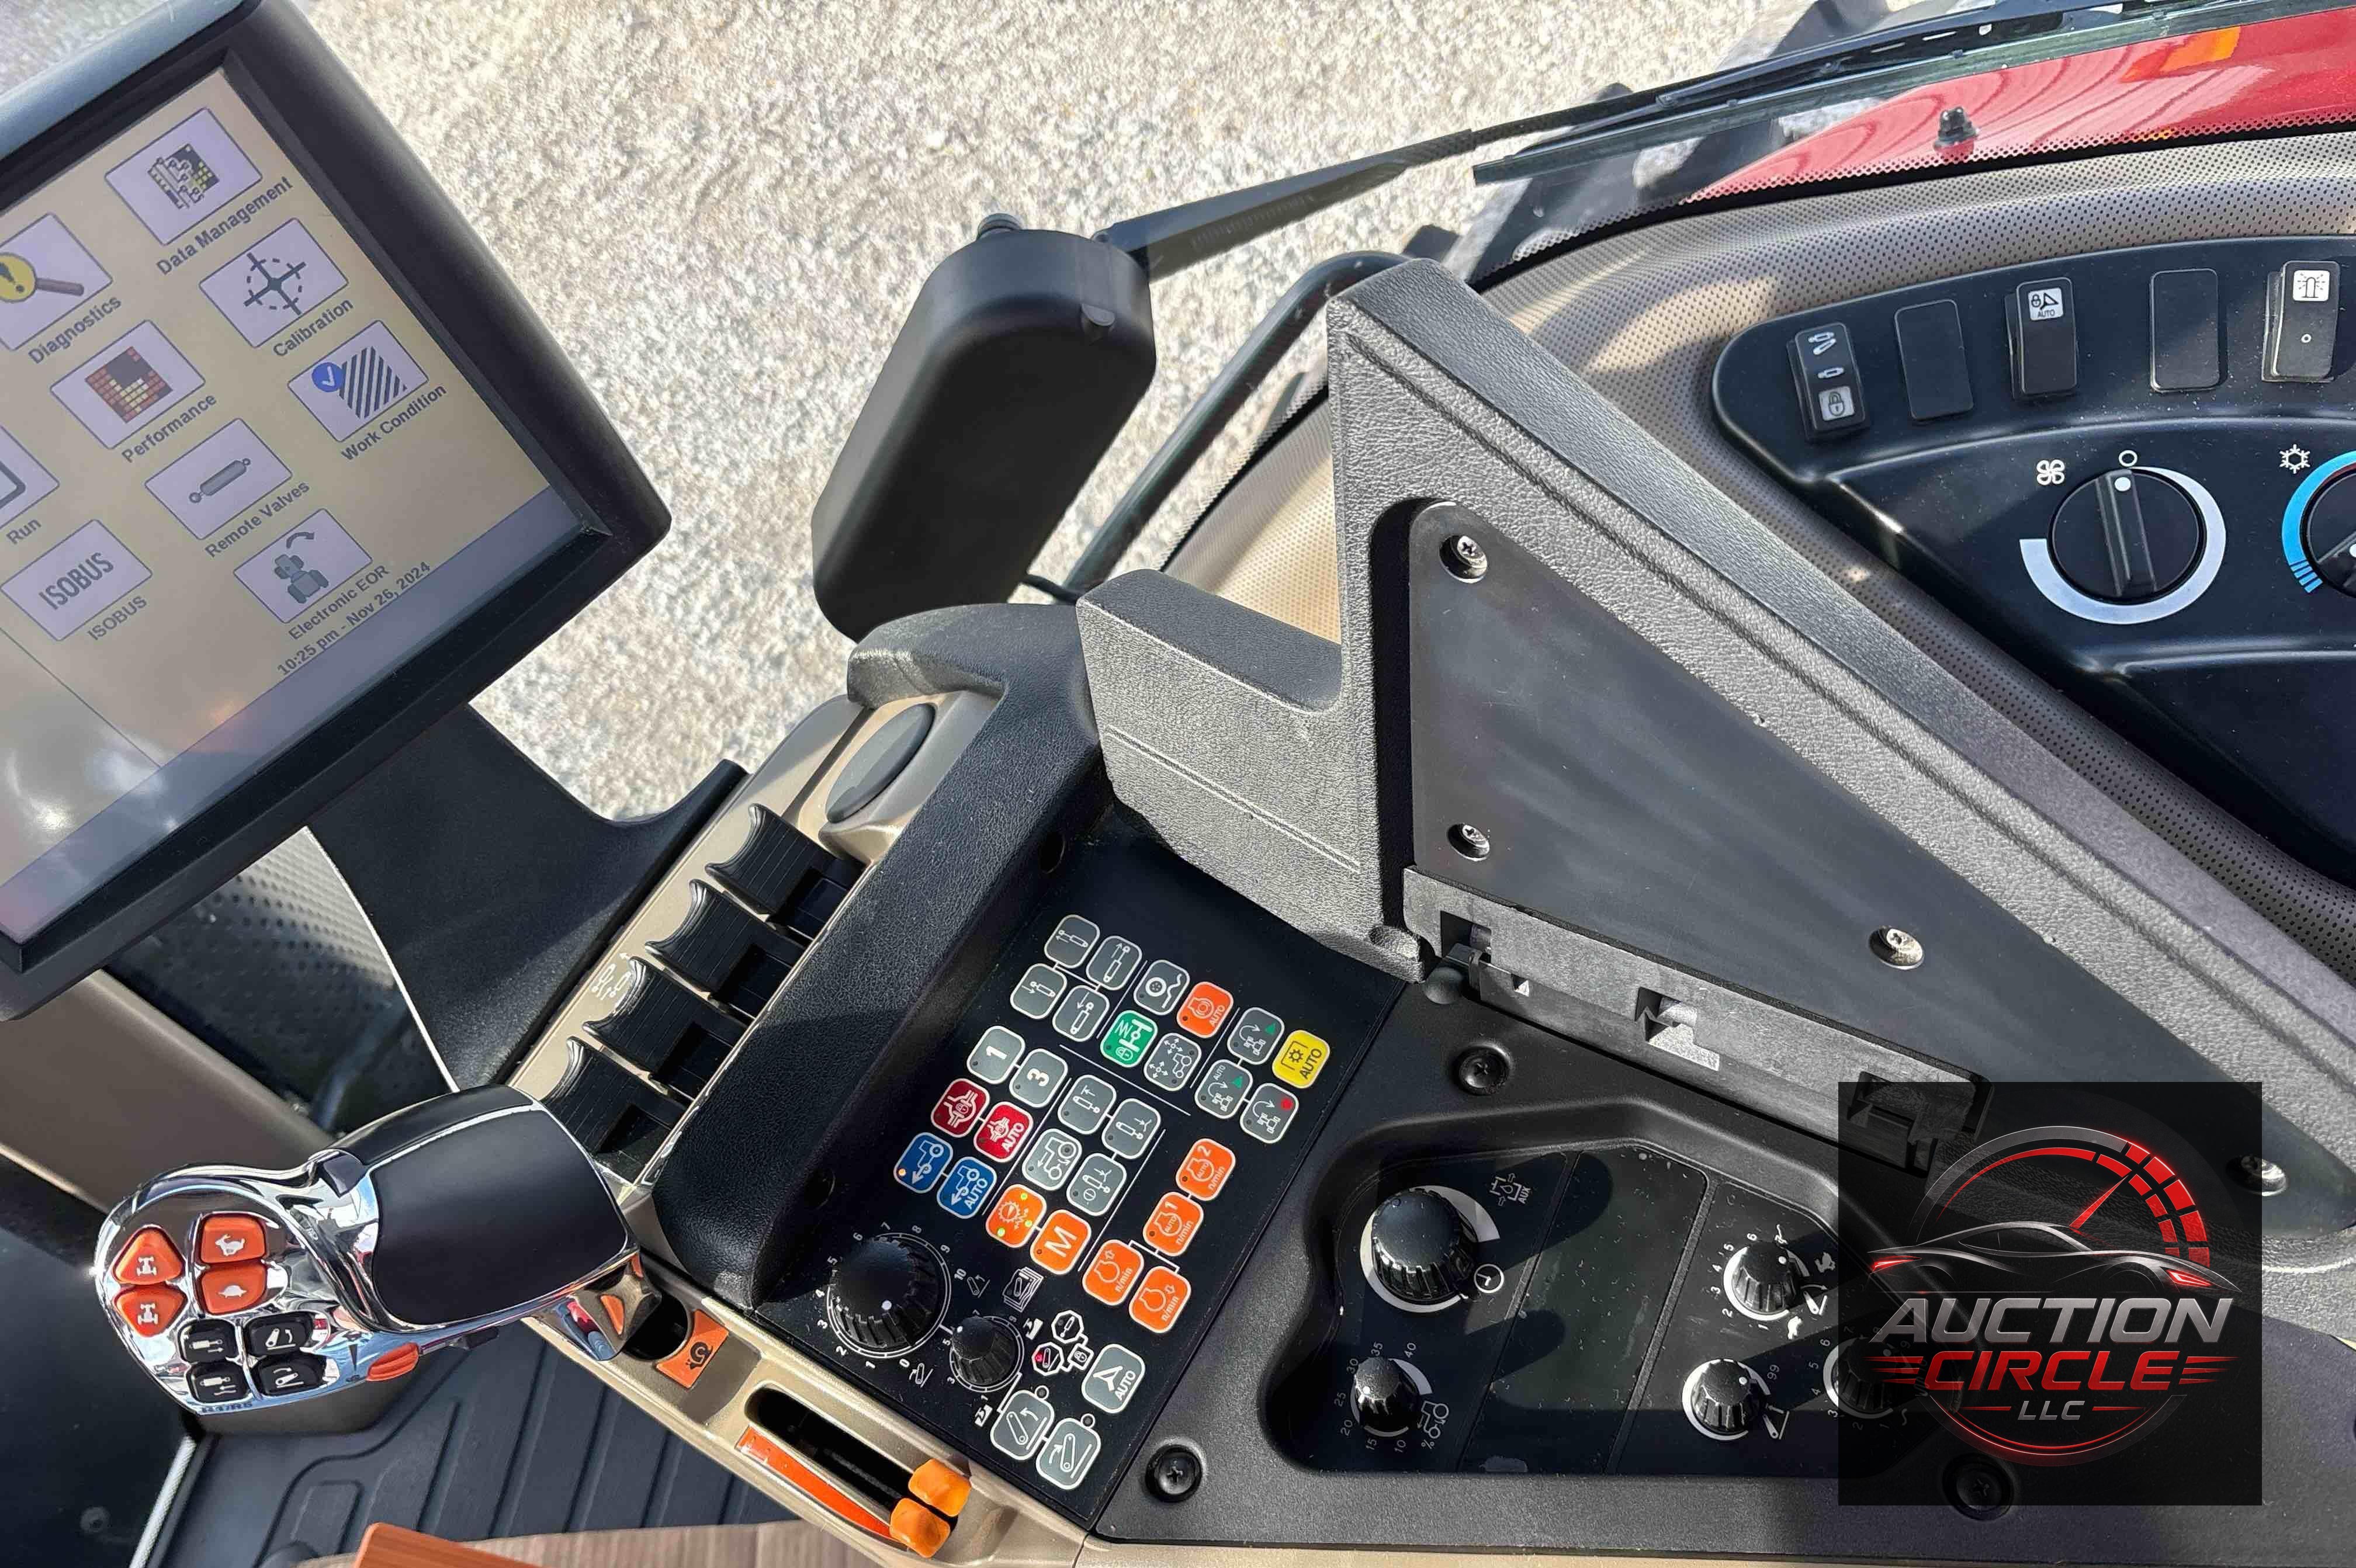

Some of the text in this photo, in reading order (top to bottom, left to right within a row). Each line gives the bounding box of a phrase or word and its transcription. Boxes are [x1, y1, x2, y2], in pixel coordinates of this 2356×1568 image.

[156, 175, 294, 276] Data Management
[2037, 309, 2056, 318] AUTO
[28, 297, 122, 363] Diagnostics
[273, 298, 354, 357] Calibration
[122, 394, 217, 463] Performance
[341, 384, 448, 462] Work Condition
[205, 482, 311, 558] Remote Valves
[6, 519, 41, 544] Run
[39, 553, 115, 610] ISOBUS
[288, 564, 390, 641] Electronic EOR
[87, 596, 147, 640] ISOBUS
[276, 645, 317, 677] 10:25
[316, 630, 339, 650] pm
[345, 602, 375, 627] Nov
[374, 588, 399, 606] 26,
[396, 561, 431, 590] 2024
[1210, 1005, 1226, 1026] AUTO
[986, 1045, 1007, 1059] 1
[1299, 1047, 1323, 1079] AUTO
[1027, 1069, 1049, 1087] 3
[1213, 1065, 1226, 1080] AUTO
[1002, 1122, 1025, 1152] AUTO
[1197, 1144, 1212, 1157] 2
[1208, 1166, 1225, 1191] n/min
[964, 1178, 988, 1209] AUTO
[1518, 1187, 1532, 1204] AUX
[1165, 1201, 1179, 1210] 1
[881, 1222, 891, 1230] 7
[912, 1225, 921, 1234] 8
[1176, 1219, 1194, 1246] n/min
[853, 1233, 863, 1241] 6
[1045, 1226, 1077, 1258] M
[1747, 1233, 1758, 1241] 6
[941, 1244, 950, 1254] 9
[1723, 1243, 1734, 1251] 5
[827, 1257, 838, 1265] 5
[1712, 1264, 1723, 1272] 4
[954, 1268, 967, 1280] 10
[1115, 1267, 1133, 1293] n/min
[816, 1289, 825, 1298] 4
[1161, 1295, 1179, 1322] n/min
[1722, 1308, 1733, 1318] 2
[818, 1320, 828, 1329] 3
[1371, 1342, 1383, 1357] 35
[1404, 1342, 1416, 1358] 40
[1820, 1338, 1831, 1347] 6
[836, 1346, 847, 1355] 2
[865, 1361, 876, 1369] 1
[899, 1358, 910, 1368] 0
[1346, 1358, 1359, 1373] 30
[1808, 1361, 1819, 1369] 5
[1115, 1370, 1137, 1402] AUTO
[1811, 1387, 1821, 1396] 4
[1334, 1392, 1346, 1407] 25
[1340, 1420, 1353, 1436] 20
[1366, 1439, 1377, 1451] 15
[1394, 1439, 1406, 1453] 10
